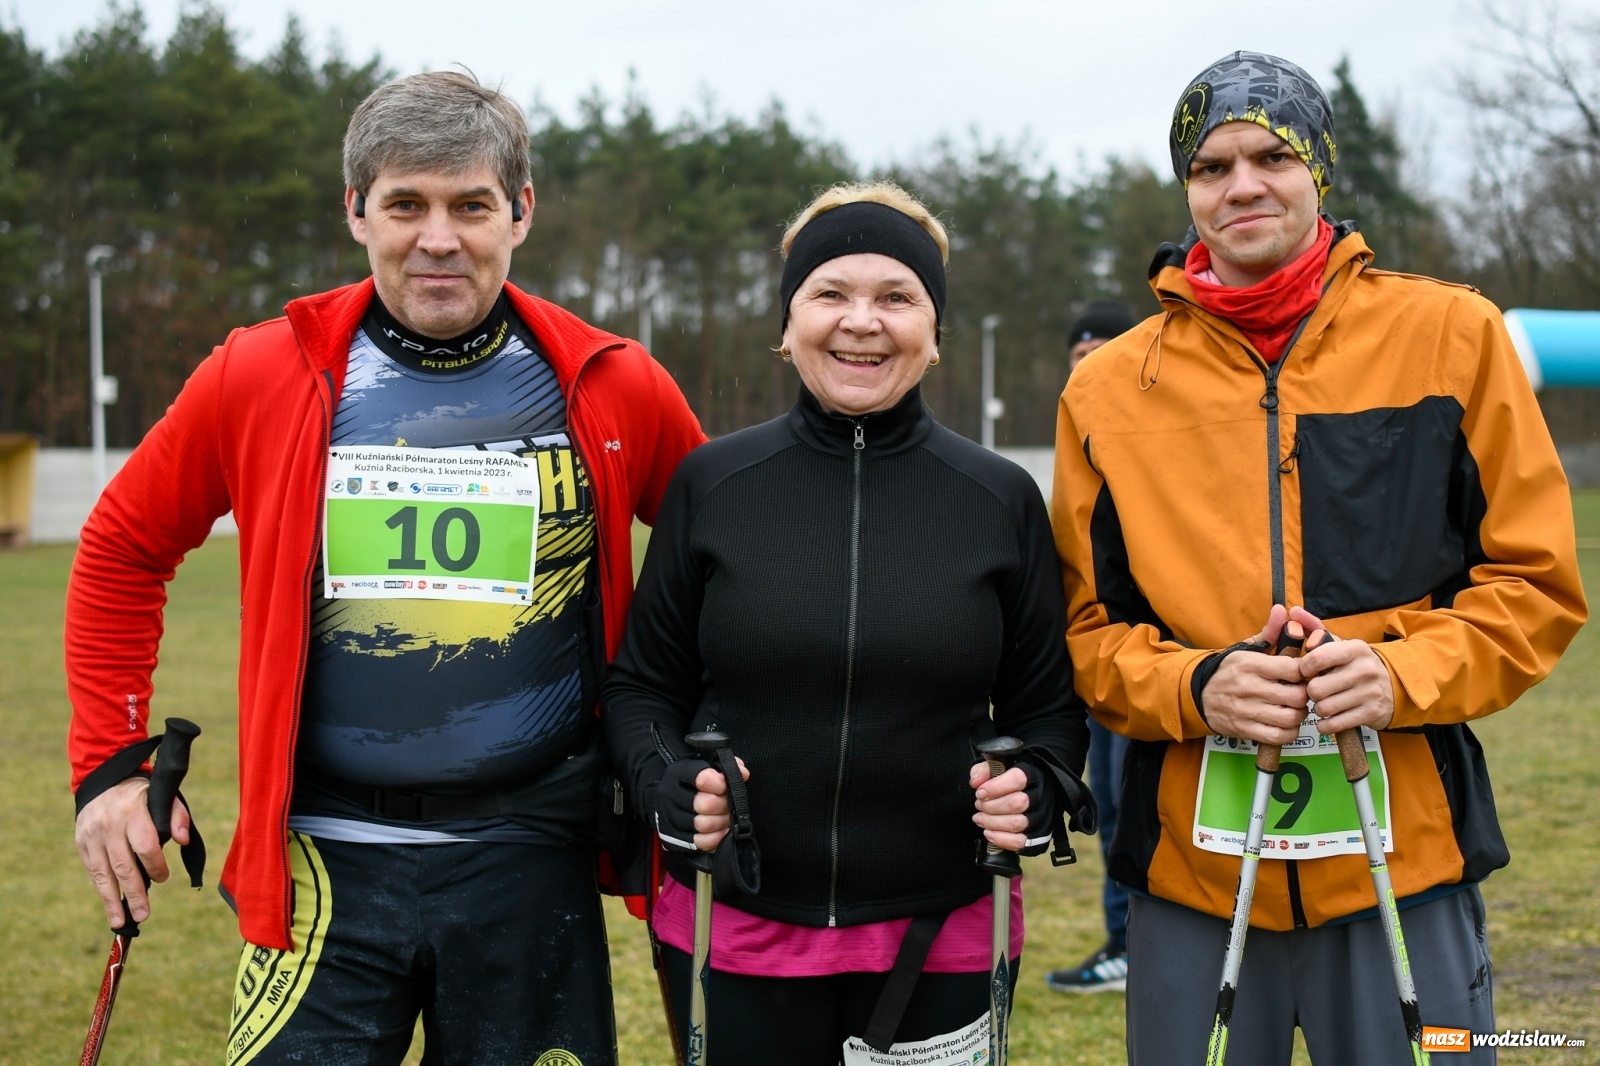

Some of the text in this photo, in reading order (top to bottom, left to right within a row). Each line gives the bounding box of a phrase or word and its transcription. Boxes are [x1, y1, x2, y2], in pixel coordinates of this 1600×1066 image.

[421, 320, 508, 369] PITBULLSPORTS
[354, 464, 384, 472] Kuźnia
[386, 465, 436, 475] Raciborska,
[438, 467, 443, 475] 1
[444, 468, 482, 476] kwietnia
[483, 469, 506, 477] 2023
[356, 453, 404, 462] Kuźniański
[405, 454, 458, 464] Półmaraton
[459, 457, 484, 466] Leśny
[485, 458, 524, 468] RAFAME
[523, 449, 577, 514] H
[384, 505, 481, 572] 10
[1271, 761, 1313, 829] 9
[1386, 887, 1410, 977] GABEL
[232, 946, 273, 1023] LUB
[233, 1025, 254, 1054] fight
[266, 969, 292, 1006] MMA
[869, 1055, 895, 1065] Kuźnia
[895, 1052, 943, 1066] Raciborska,
[950, 1038, 981, 1056] kwietnia
[912, 1037, 961, 1056] Półmaraton
[961, 1026, 979, 1042] Leśny
